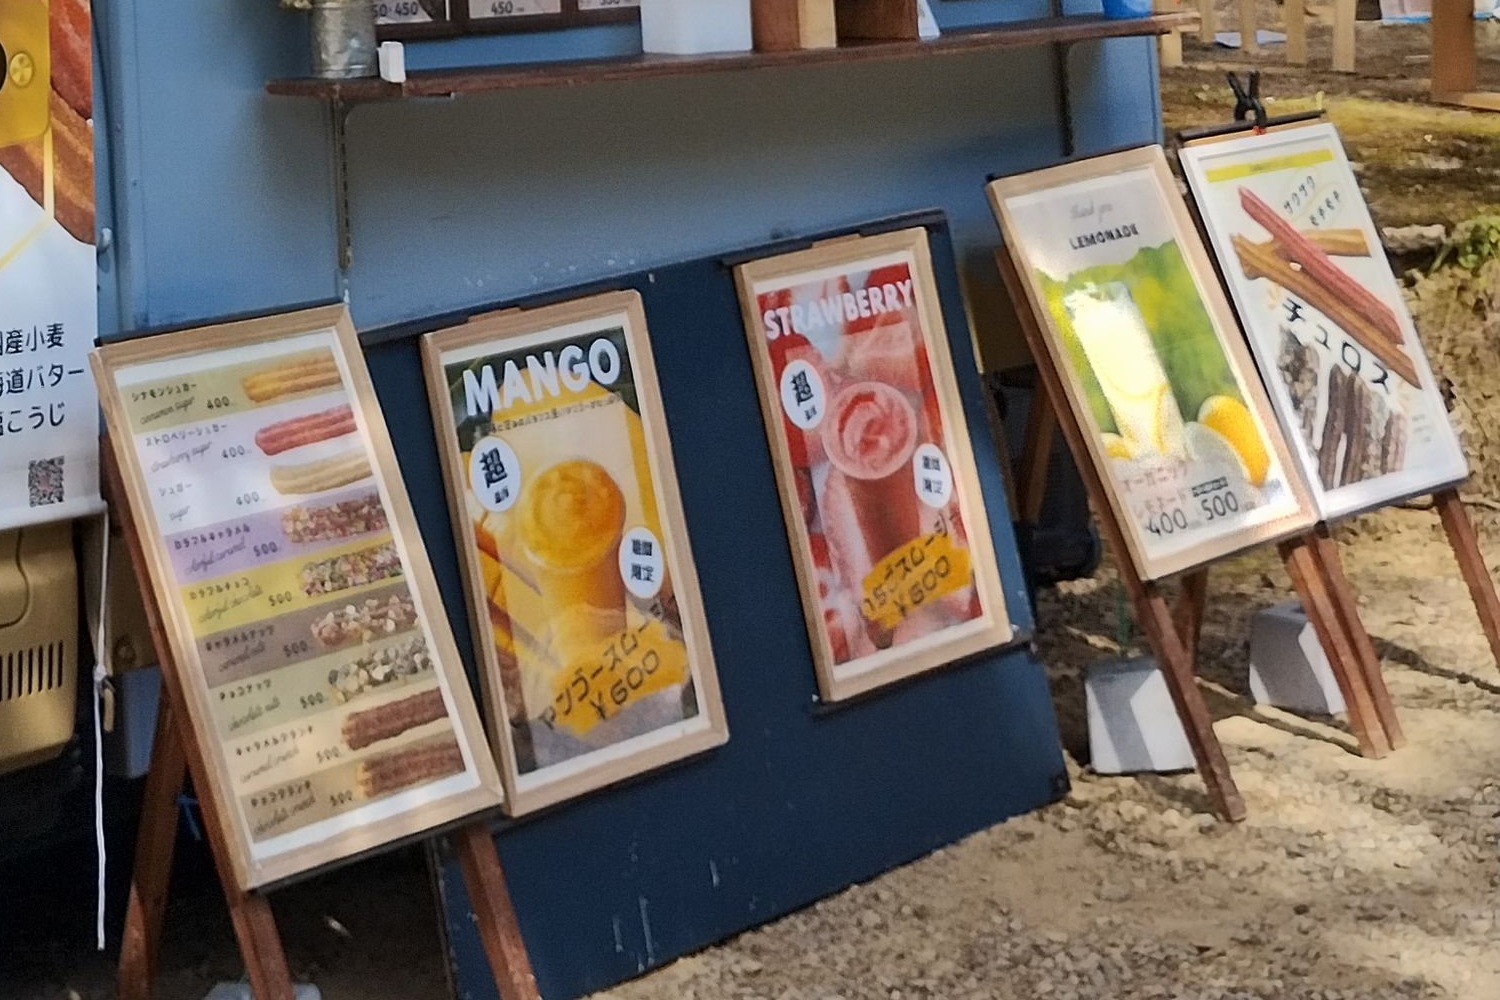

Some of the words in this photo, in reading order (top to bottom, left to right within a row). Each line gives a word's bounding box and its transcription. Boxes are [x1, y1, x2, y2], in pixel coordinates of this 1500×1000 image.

[491, 1, 514, 14] 450
[1068, 223, 1139, 250] LEMONADE
[763, 279, 913, 340] STRAWBERRY
[463, 338, 620, 416] MANGO
[207, 396, 230, 410] 400
[221, 444, 245, 459] 400
[479, 447, 508, 488] 超
[236, 491, 260, 506] 400
[1145, 508, 1188, 536] 400
[1201, 491, 1239, 520] 500
[253, 541, 278, 557] 500
[269, 591, 292, 607] 500
[589, 650, 659, 720] ¥600
